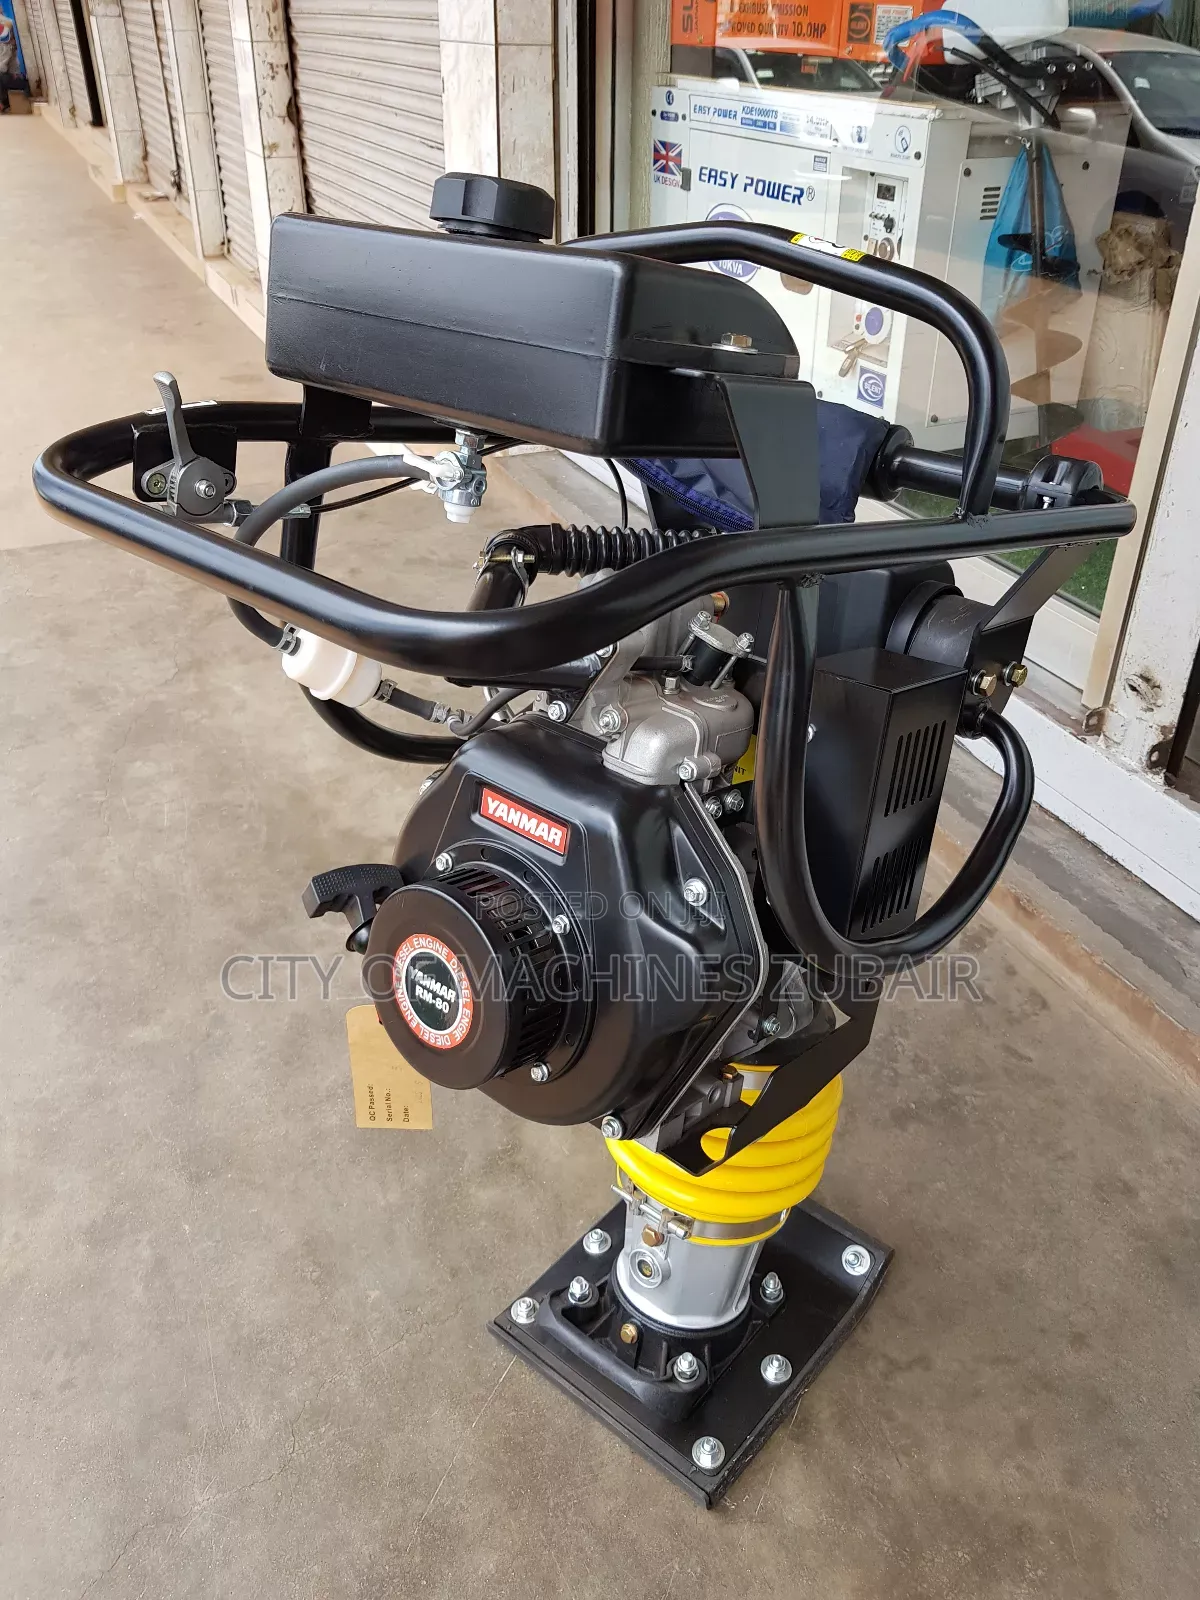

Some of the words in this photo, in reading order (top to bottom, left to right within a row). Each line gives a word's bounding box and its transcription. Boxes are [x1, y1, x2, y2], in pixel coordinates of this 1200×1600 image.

[792, 21, 827, 39] 10.0HP
[693, 104, 712, 115] EASY
[712, 107, 738, 120] POWER
[653, 174, 660, 183] UK
[661, 176, 680, 188] DESIGN
[698, 166, 739, 190] EASY
[487, 796, 563, 847] YANMAR
[395, 942, 414, 978] DIESEL
[413, 936, 449, 960] ENGINE
[408, 965, 457, 1004] YANMAR
[449, 958, 471, 1005] DIESEL
[395, 982, 419, 1028] ENGINE
[415, 984, 451, 1014] RM-80
[419, 1027, 452, 1046] DIESEL
[452, 1009, 471, 1041] ENGIE
[366, 1083, 376, 1110] Passed:
[368, 1110, 376, 1122] QC
[385, 1102, 393, 1122] Serial
[402, 1105, 410, 1123] Date:
